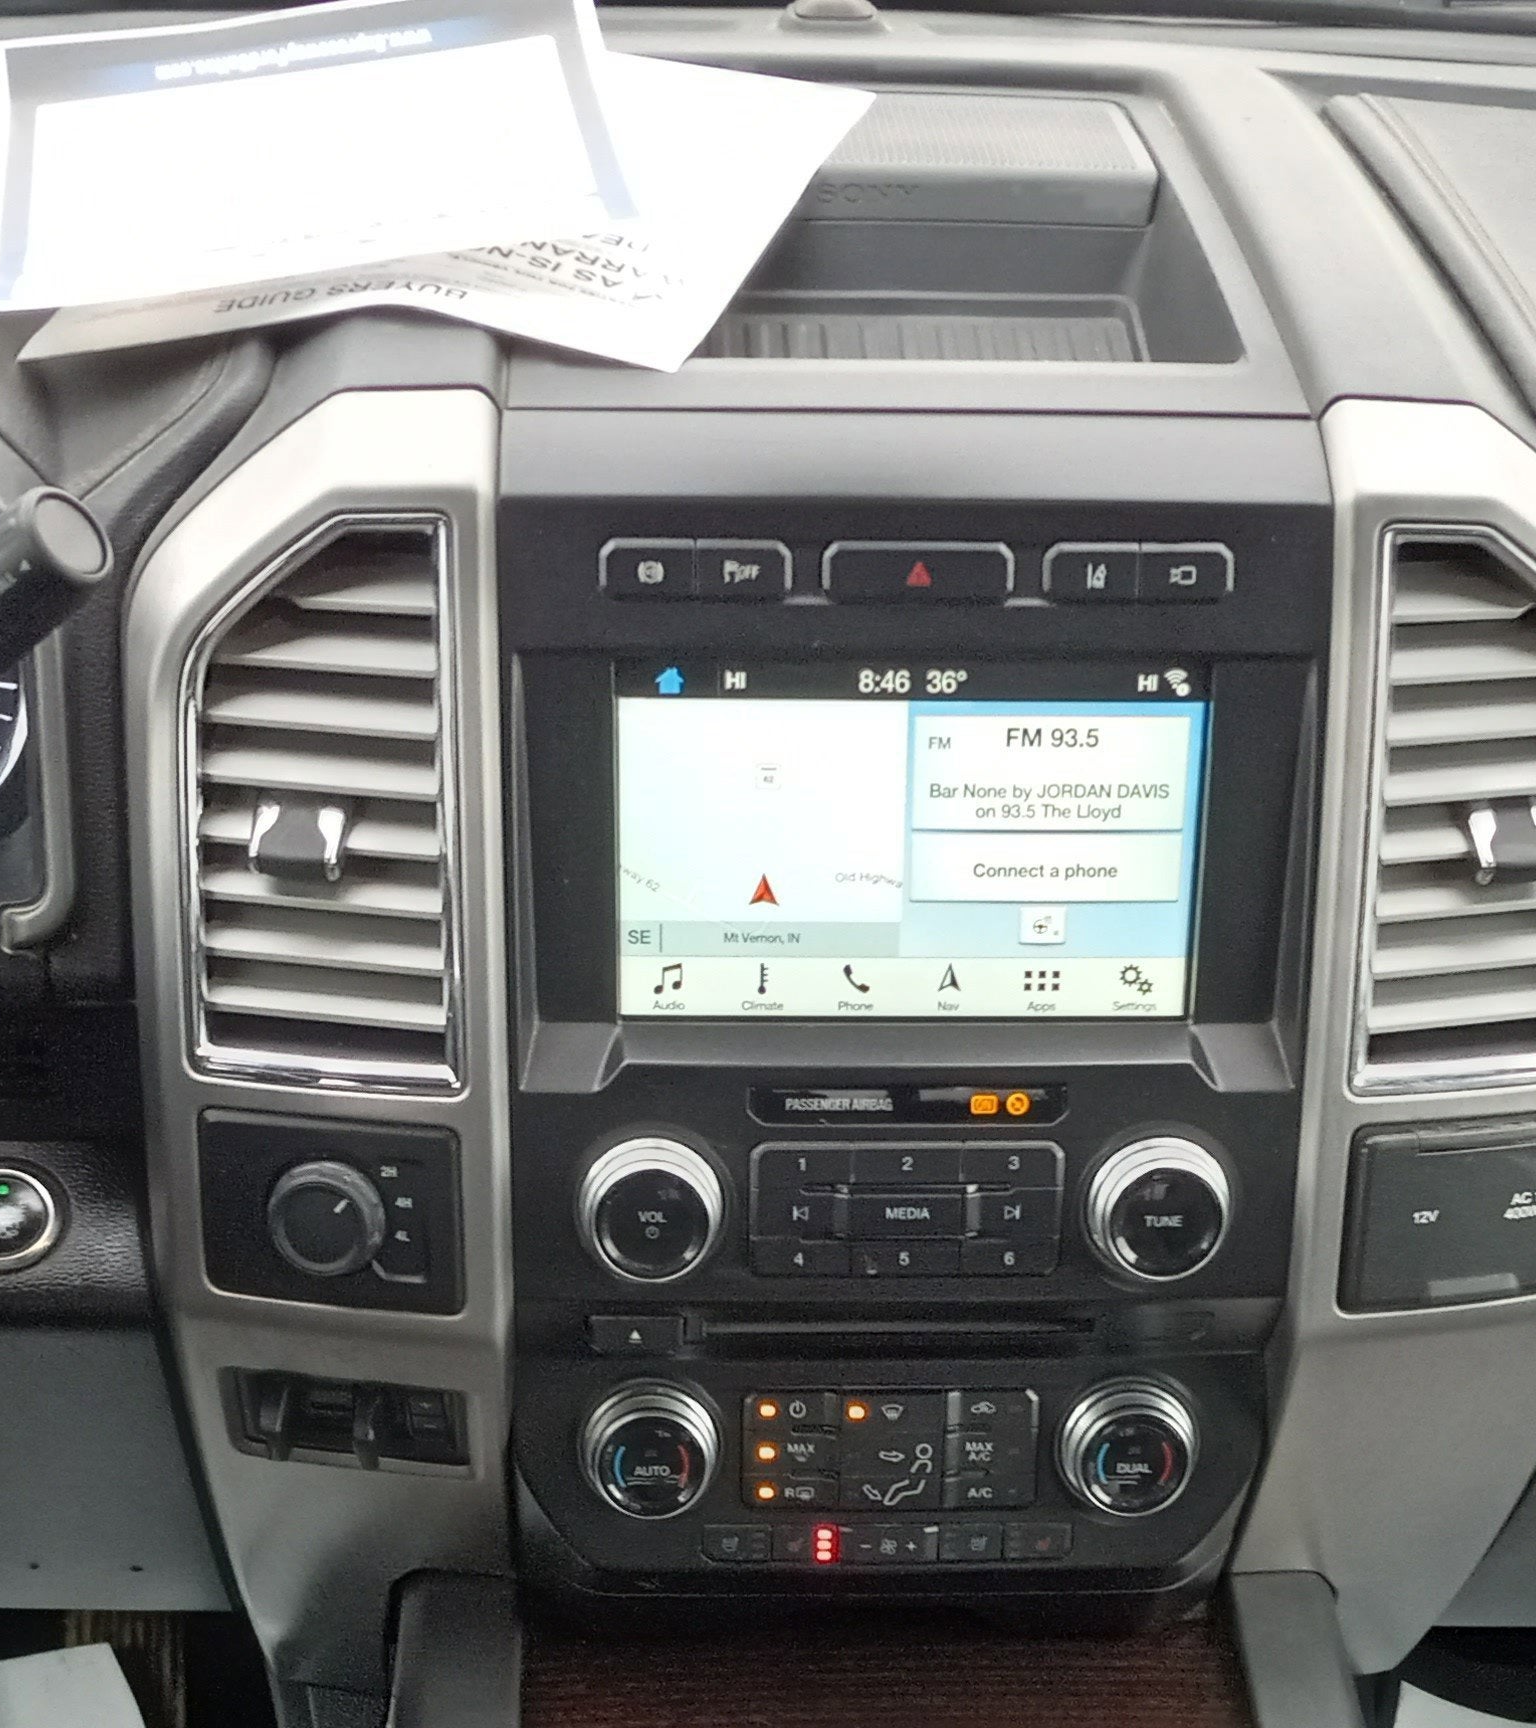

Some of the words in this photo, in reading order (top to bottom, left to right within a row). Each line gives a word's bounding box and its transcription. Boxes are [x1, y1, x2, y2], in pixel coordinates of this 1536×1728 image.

[214, 287, 316, 313] GUIDE
[725, 670, 747, 691] HI
[858, 670, 911, 693] 8:46
[926, 669, 967, 693] 36°
[1137, 672, 1159, 693] HI
[928, 735, 952, 751] FM
[1006, 728, 1042, 749] FM
[1050, 728, 1100, 749] 93.5
[929, 783, 959, 799] Bar
[964, 783, 1007, 799] None
[1011, 783, 1032, 804] by
[1037, 783, 1112, 799] JORDAN
[1117, 783, 1170, 799] DAVIS
[975, 806, 996, 820] on
[1001, 804, 1037, 820] 93.5
[1042, 804, 1074, 820] The
[1078, 803, 1122, 824] Lloyd
[973, 862, 1045, 879] Connect
[1050, 865, 1061, 879] a
[1066, 862, 1118, 883] phone
[627, 929, 652, 945] SE
[723, 932, 739, 944] Mt
[741, 932, 785, 946] Vernon,
[787, 932, 801, 944] IN
[652, 1000, 685, 1012] Audio
[741, 1000, 784, 1012] Climate
[837, 1000, 874, 1012] Phone
[937, 1001, 959, 1012] Nav
[1026, 1000, 1056, 1014] Apps
[1112, 1000, 1157, 1015] Settings
[785, 1097, 849, 1112] PASSENGER
[851, 1097, 894, 1113] AIRBAG
[798, 1157, 807, 1171] 1
[901, 1157, 913, 1171] 2
[1008, 1157, 1020, 1171] 3
[1511, 1191, 1532, 1206] AC
[638, 1210, 667, 1224] VOL
[886, 1206, 930, 1221] MEDIA
[1413, 1209, 1440, 1225] 12V
[1144, 1215, 1184, 1228] TUNE
[793, 1252, 804, 1266] 4
[898, 1252, 910, 1266] 5
[1003, 1252, 1015, 1266] 6
[787, 1443, 816, 1455] MAX
[965, 1442, 994, 1453] MAX
[967, 1450, 992, 1462] A/C
[633, 1465, 672, 1477] AUTO
[1116, 1462, 1153, 1475] DUAL
[785, 1486, 796, 1499] R
[967, 1486, 993, 1498] A/C
